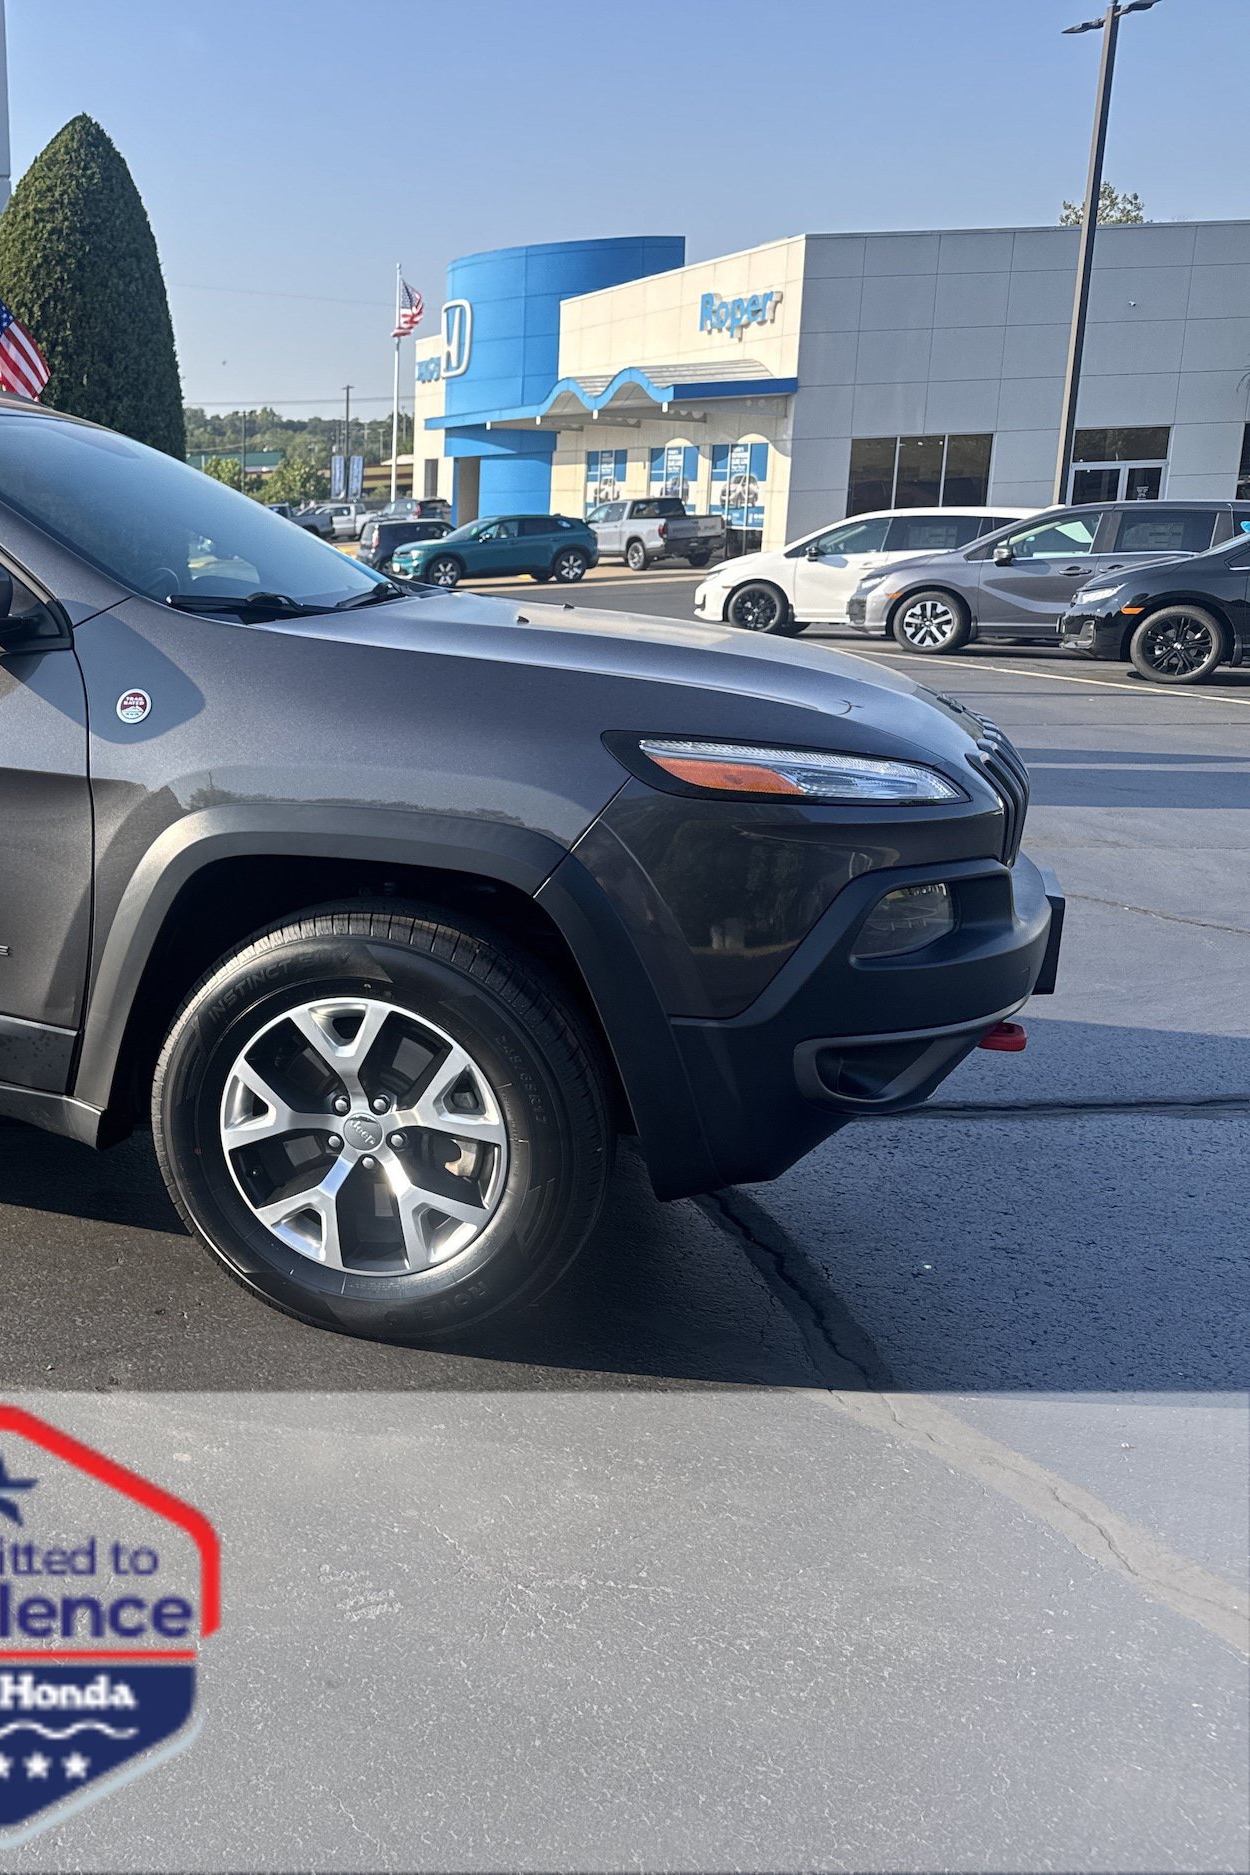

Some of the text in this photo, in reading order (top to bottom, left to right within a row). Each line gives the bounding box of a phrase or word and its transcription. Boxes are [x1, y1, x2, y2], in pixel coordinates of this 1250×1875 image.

[699, 291, 780, 340] Roper
[207, 950, 352, 1024] INSTINCT SV
[349, 1119, 377, 1146] Jeep
